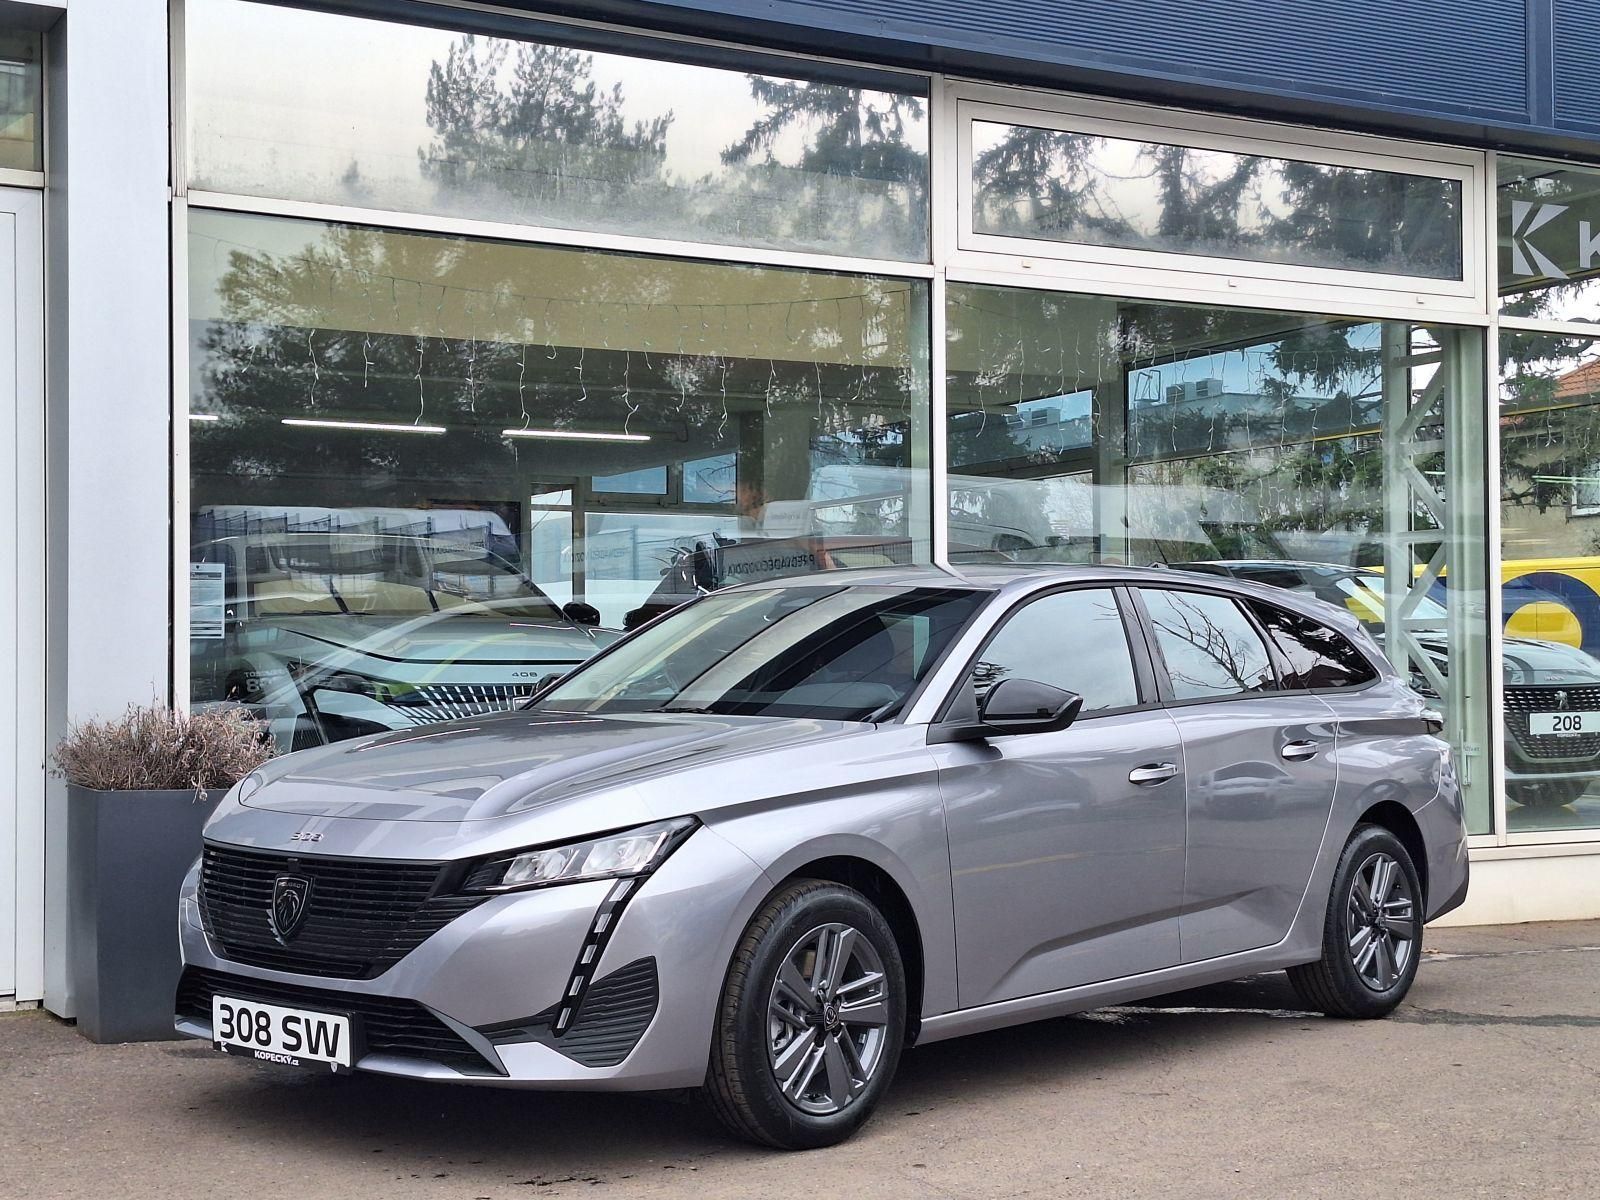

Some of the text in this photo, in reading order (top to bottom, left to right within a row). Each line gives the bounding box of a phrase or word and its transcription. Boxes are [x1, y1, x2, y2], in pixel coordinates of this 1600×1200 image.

[1552, 715, 1582, 732] 208
[219, 1003, 341, 1058] 308 SW
